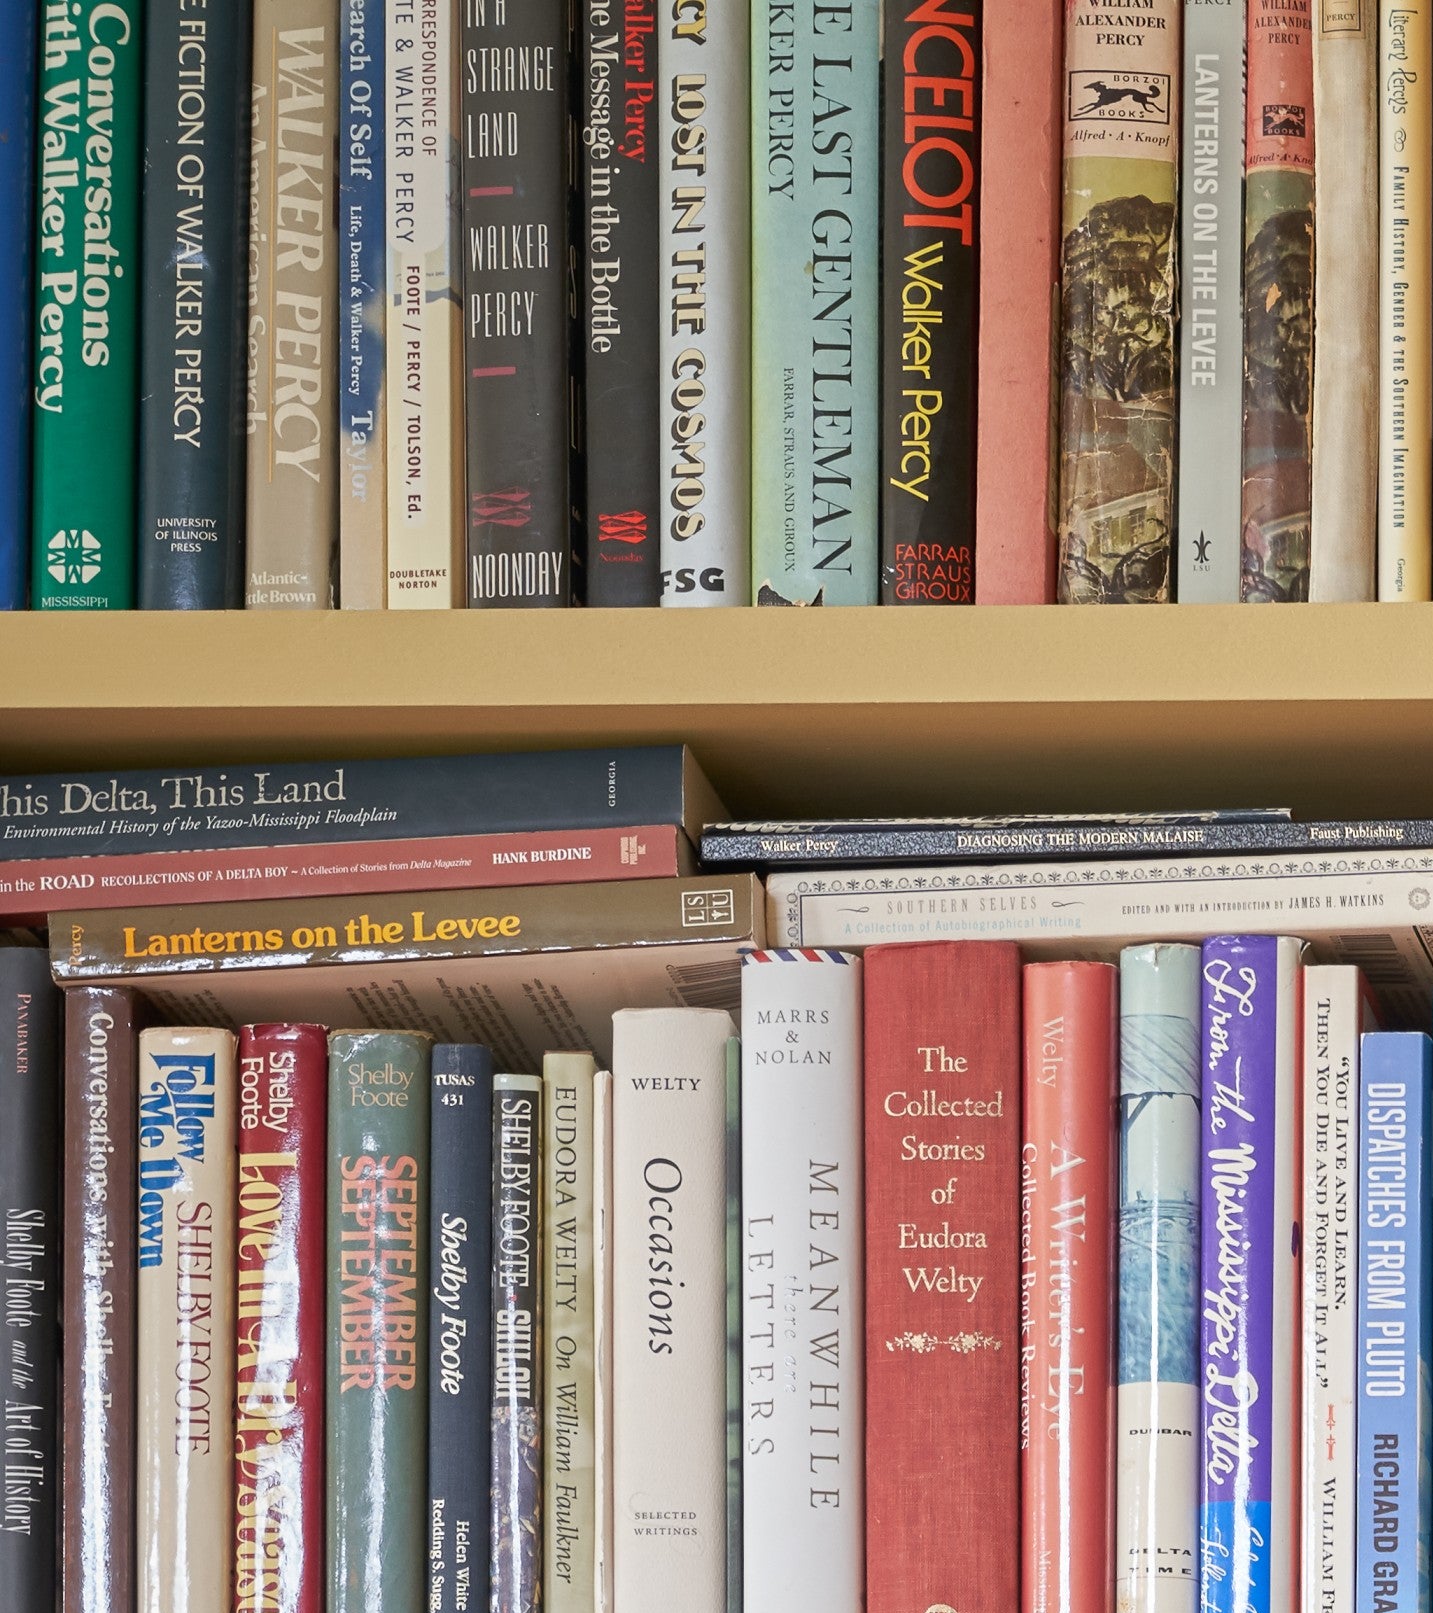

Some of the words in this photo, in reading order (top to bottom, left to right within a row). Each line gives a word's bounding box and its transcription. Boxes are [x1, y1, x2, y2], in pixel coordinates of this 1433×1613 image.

[810, 56, 853, 186] LAST
[470, 224, 550, 272] WALKER
[471, 294, 533, 339] PERCY
[810, 208, 854, 575] GENTLEMAN
[157, 518, 216, 529] UNIVERSITY
[155, 530, 170, 540] OF
[172, 530, 218, 542] ILLINOIS
[171, 542, 201, 552] PRESS
[896, 544, 971, 562] FARRAR
[390, 569, 447, 580] DOUBLETAKE
[472, 552, 562, 600] NOONDAY
[896, 564, 971, 581] STRAUS
[399, 580, 438, 589] NORTON
[896, 582, 971, 602] GIROUX
[41, 596, 108, 608] MISSISSIPPI
[958, 832, 1042, 847] DIAGNOSING
[1047, 832, 1074, 844] THE
[1079, 830, 1136, 844] MODERN
[1141, 830, 1203, 843] MALAISE
[1310, 827, 1341, 840] Faust
[1346, 826, 1403, 840] Publishing
[760, 840, 800, 852] Walker
[805, 838, 837, 853] Percy
[492, 851, 527, 865] HANK
[530, 848, 591, 863] BURDINE
[124, 922, 283, 958] Lanterns
[292, 923, 338, 949] on
[345, 916, 403, 945] the
[412, 912, 520, 941] Levee
[918, 1047, 967, 1073] The
[434, 1074, 475, 1086] TUSAS
[632, 1077, 701, 1091] WELTY
[441, 1094, 464, 1105] 431
[885, 1090, 1003, 1117] Collected
[901, 1136, 984, 1162] Stories
[932, 1178, 956, 1205] of
[899, 1223, 987, 1250] Eudora
[906, 1268, 984, 1300] Welty
[634, 1511, 696, 1520] SELECTED
[634, 1528, 698, 1538] WRITINGS
